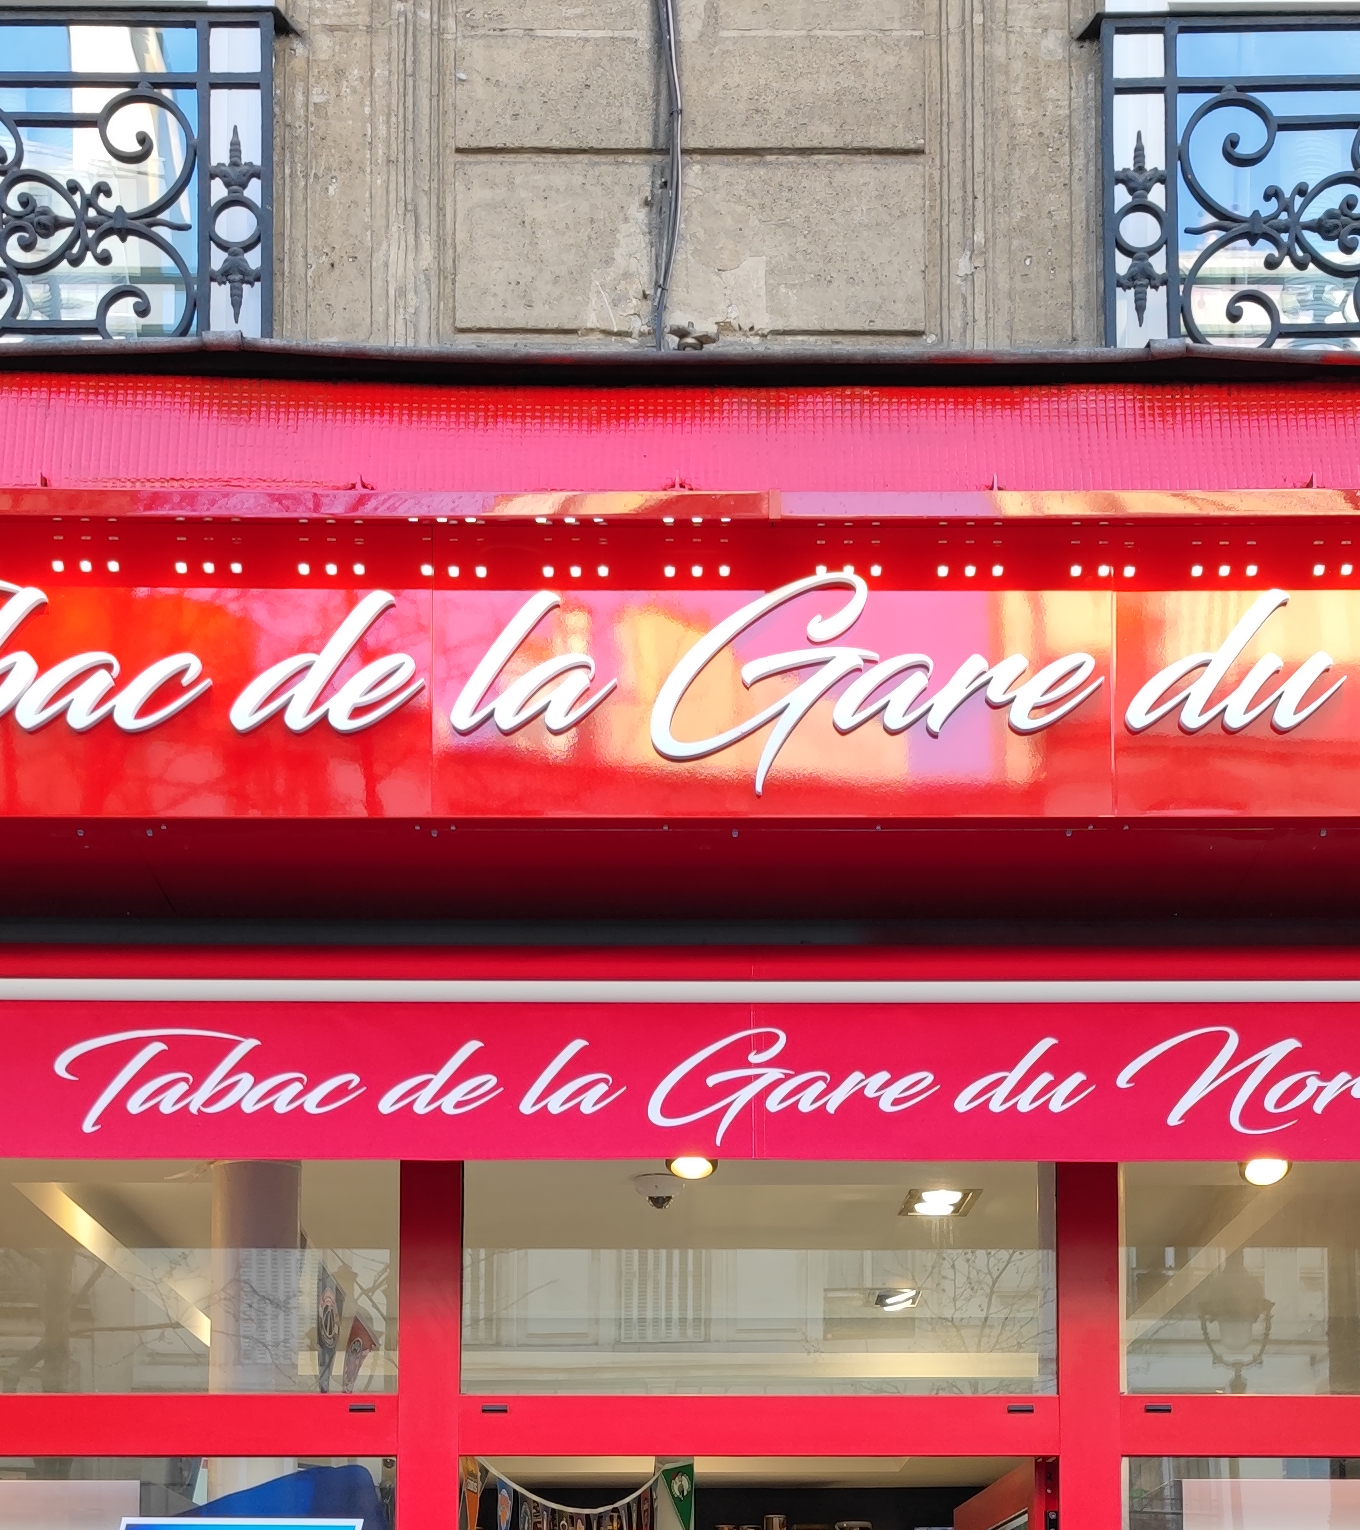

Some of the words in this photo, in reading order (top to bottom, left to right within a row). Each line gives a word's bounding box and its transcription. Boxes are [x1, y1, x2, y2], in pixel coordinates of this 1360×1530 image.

[227, 589, 425, 736] de
[449, 590, 618, 738] la
[649, 570, 1105, 796] Gare
[1125, 589, 1347, 736] du
[53, 1027, 367, 1134] Tabac
[378, 1039, 501, 1117] de
[518, 1038, 627, 1117] la
[646, 1027, 941, 1148] Gare
[952, 1036, 1099, 1116] du
